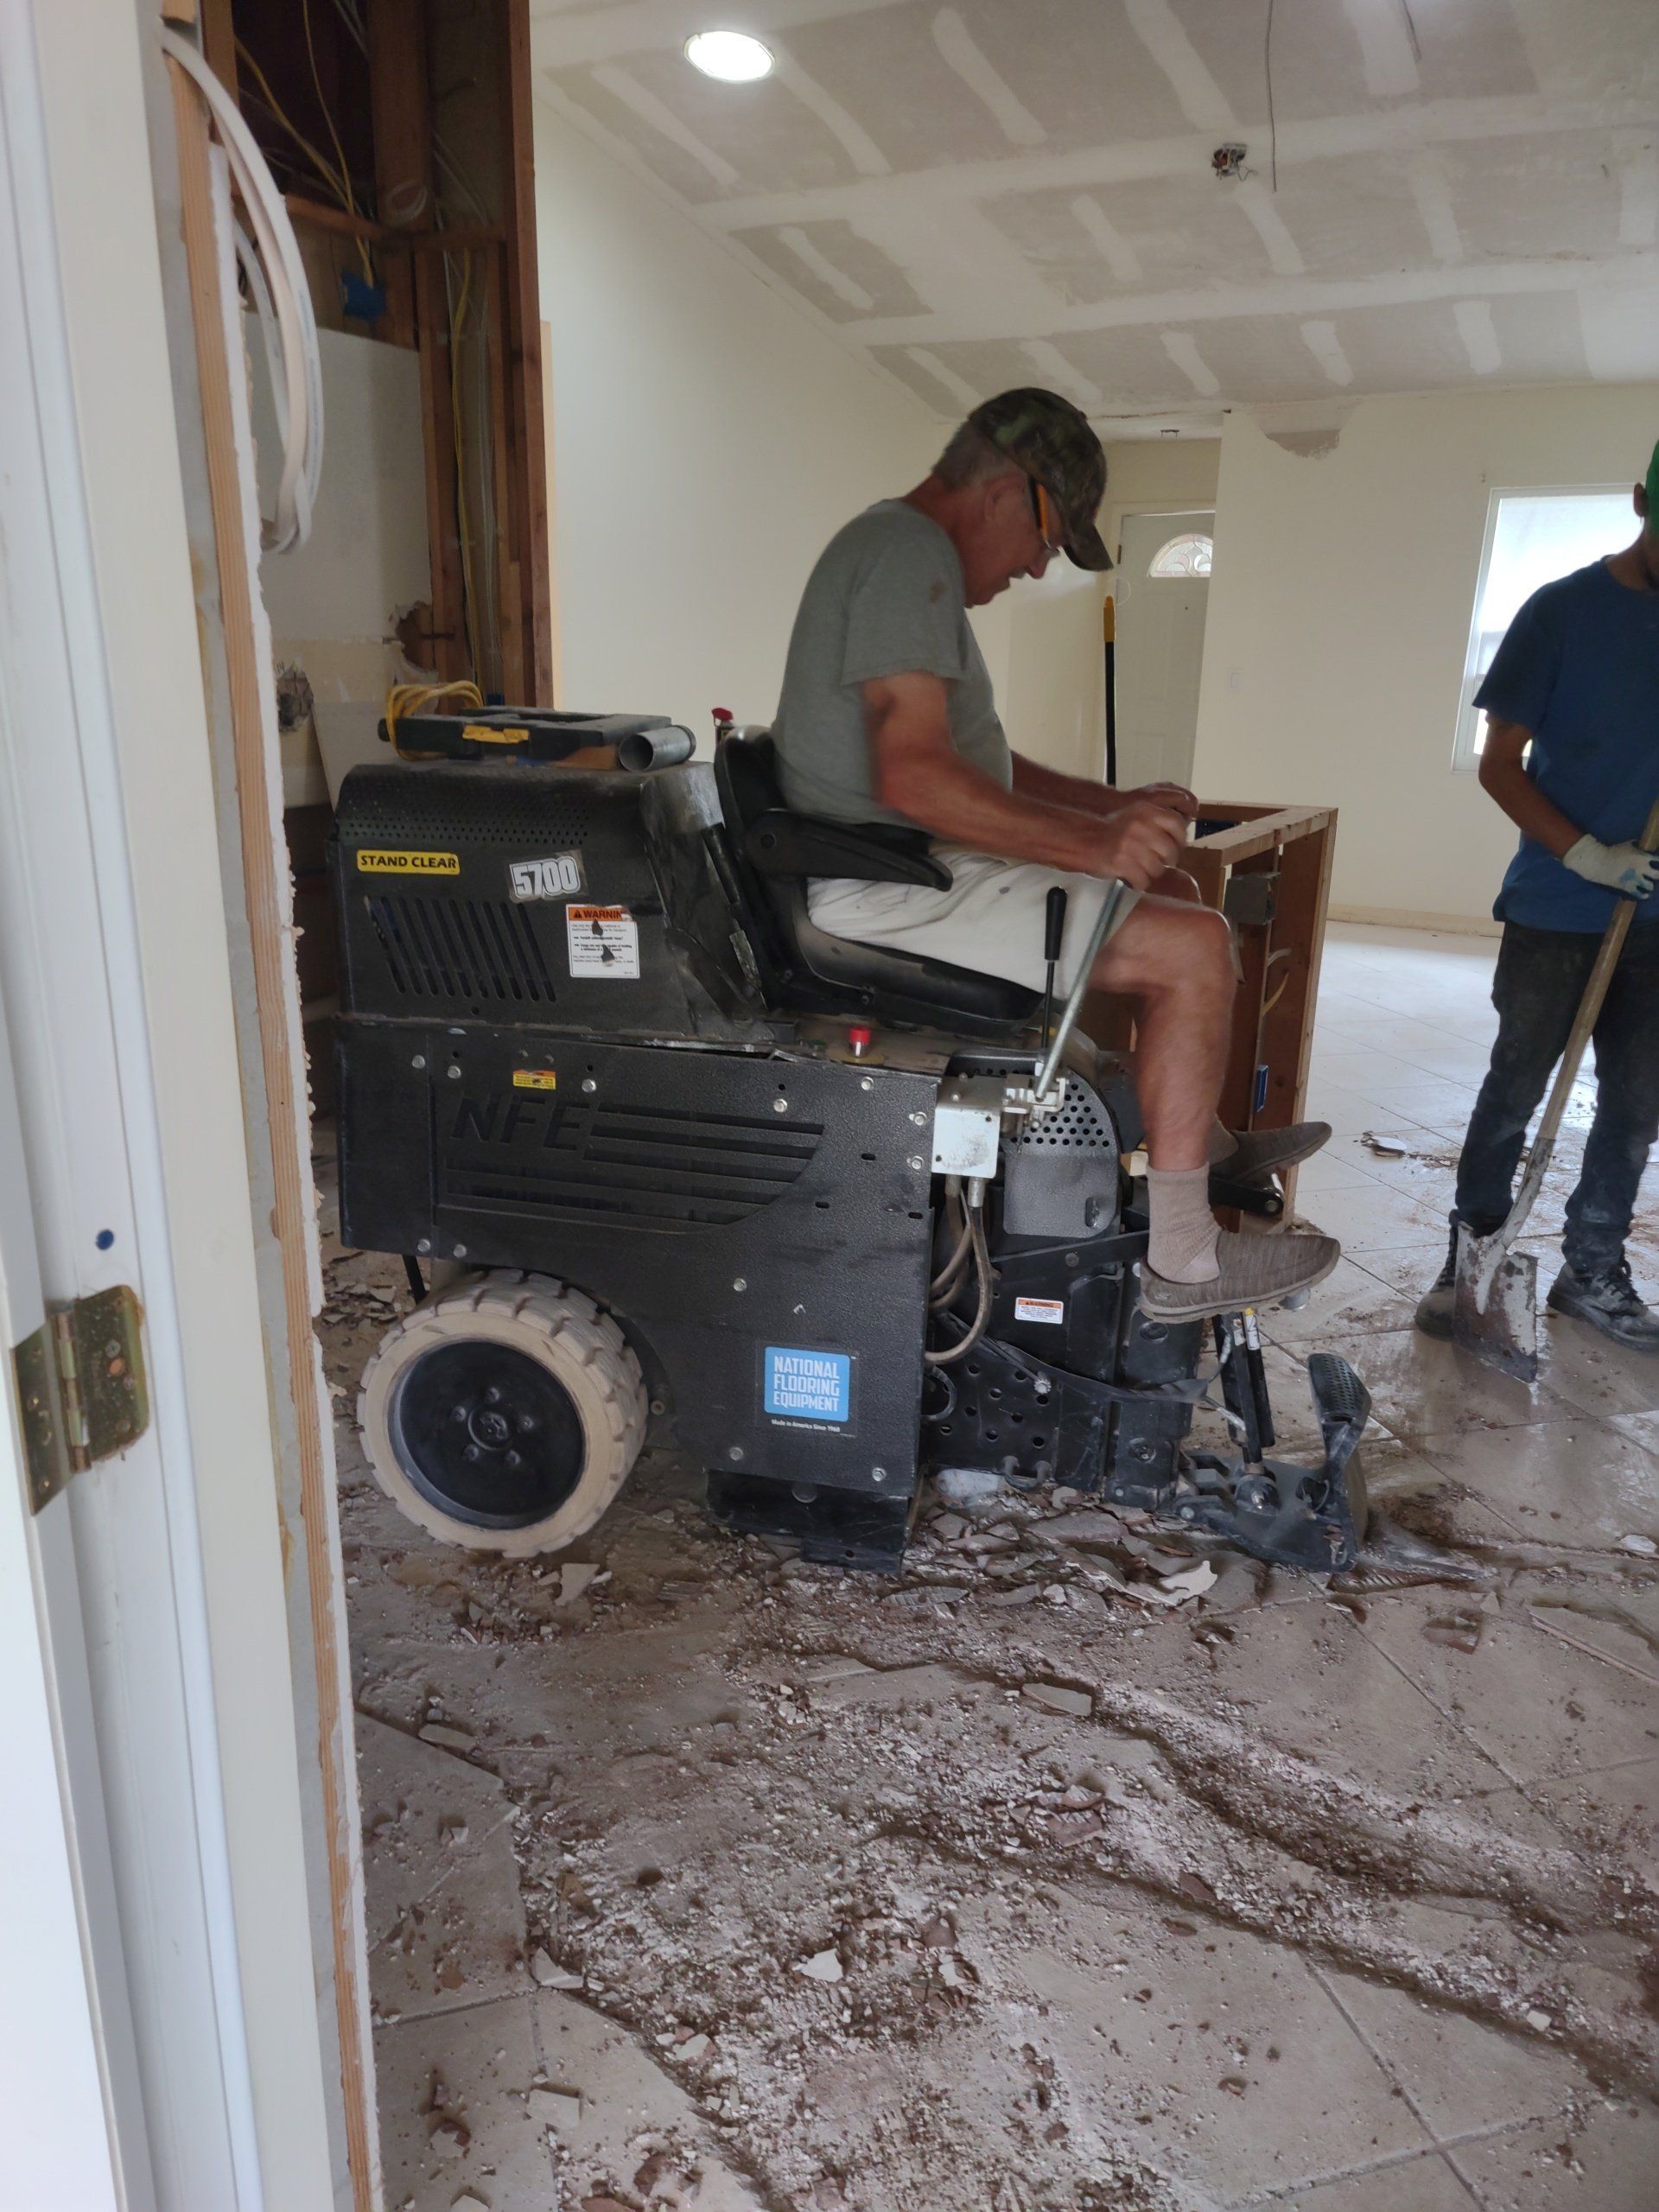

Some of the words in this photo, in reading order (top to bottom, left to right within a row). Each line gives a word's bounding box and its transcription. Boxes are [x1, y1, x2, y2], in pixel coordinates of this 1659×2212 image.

[360, 855, 408, 868] STAND
[411, 856, 456, 869] CLEAR
[510, 856, 580, 899] 5700
[583, 909, 623, 919] WARNIN
[451, 1093, 590, 1151] NFE
[773, 1356, 840, 1380] NATIONAL
[773, 1373, 840, 1397] FLOORING
[773, 1390, 839, 1412] EQUIPMENT
